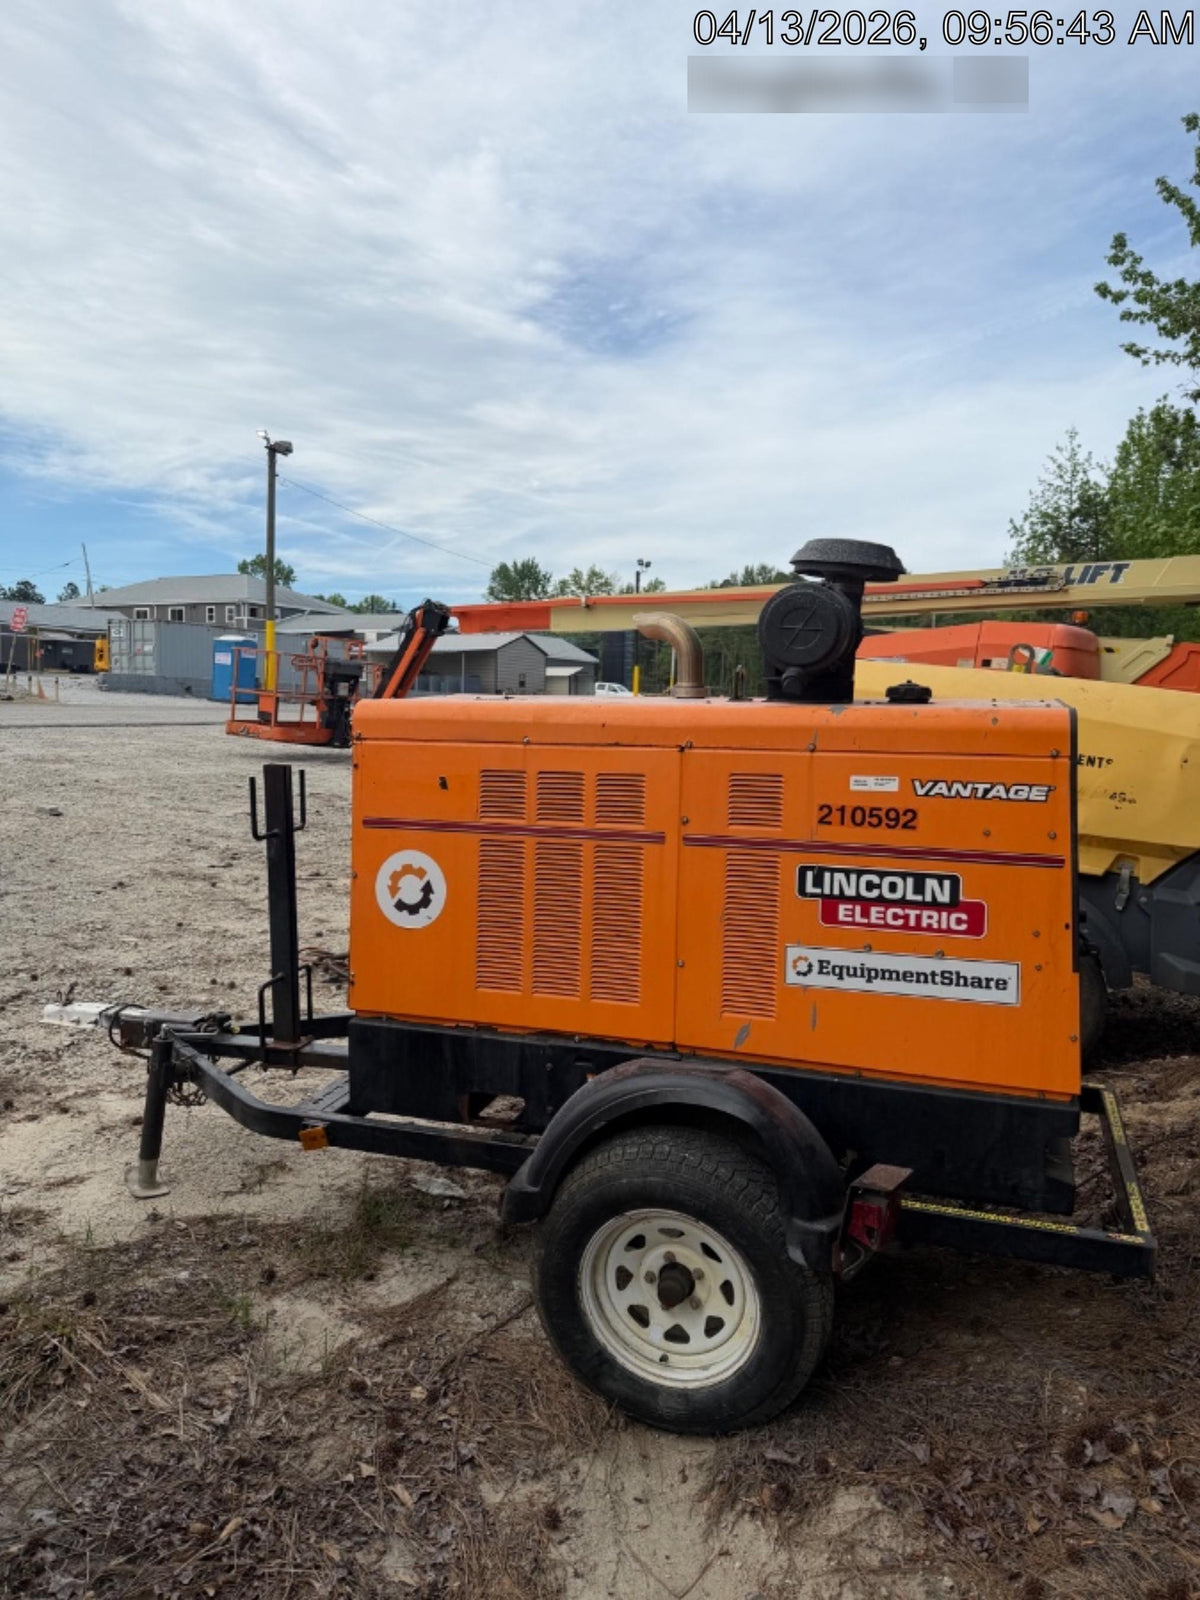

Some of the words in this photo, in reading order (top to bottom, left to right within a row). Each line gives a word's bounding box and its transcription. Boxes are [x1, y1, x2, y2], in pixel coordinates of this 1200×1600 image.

[1064, 562, 1130, 585] LIFT
[911, 779, 1050, 802] VANTAGE
[817, 804, 918, 830] 210592
[804, 869, 951, 904] LINCOLN
[837, 904, 969, 931] ELECTRIC
[816, 959, 1009, 991] EquipmentShare
